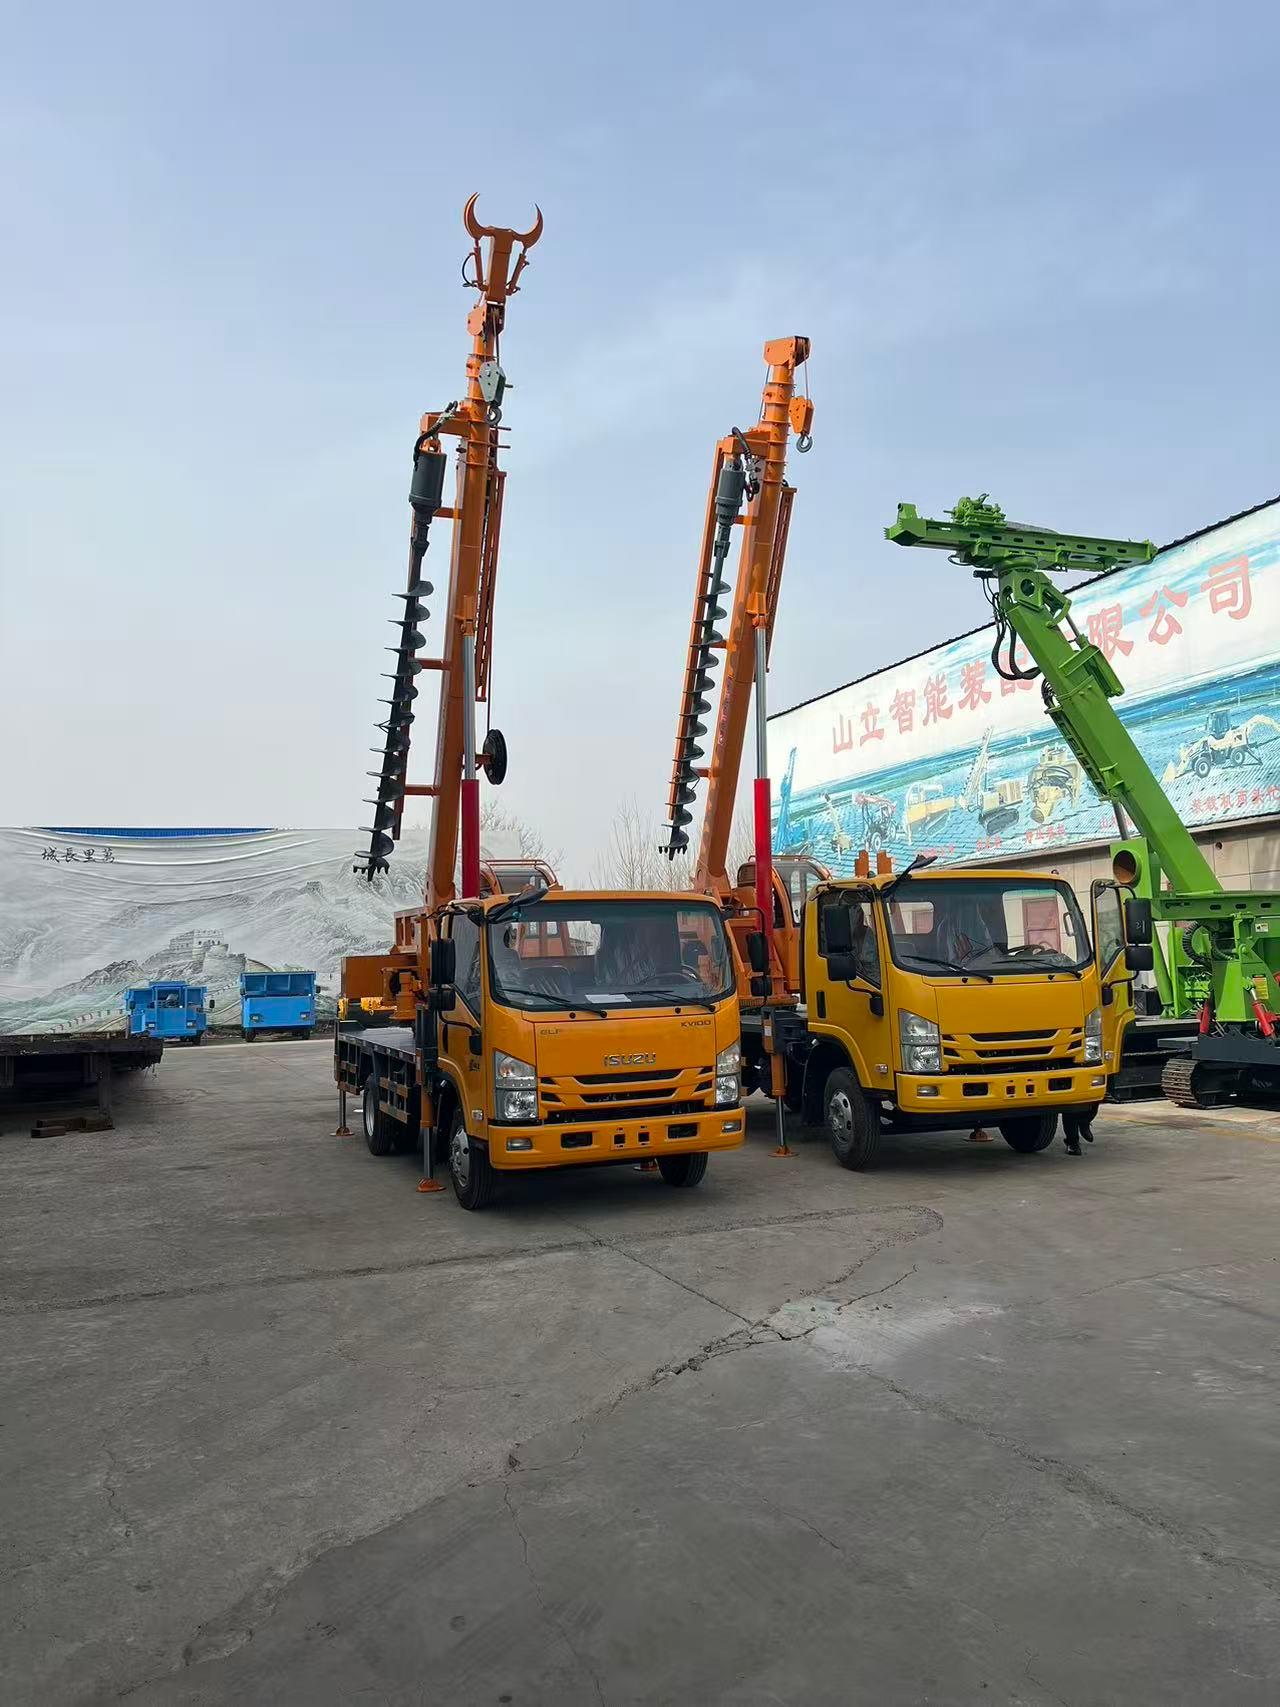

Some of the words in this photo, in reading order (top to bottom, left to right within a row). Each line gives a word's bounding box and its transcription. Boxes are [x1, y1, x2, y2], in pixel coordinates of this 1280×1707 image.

[832, 554, 1254, 754] 山立智能装配限公司
[604, 1052, 657, 1067] ISUZU
